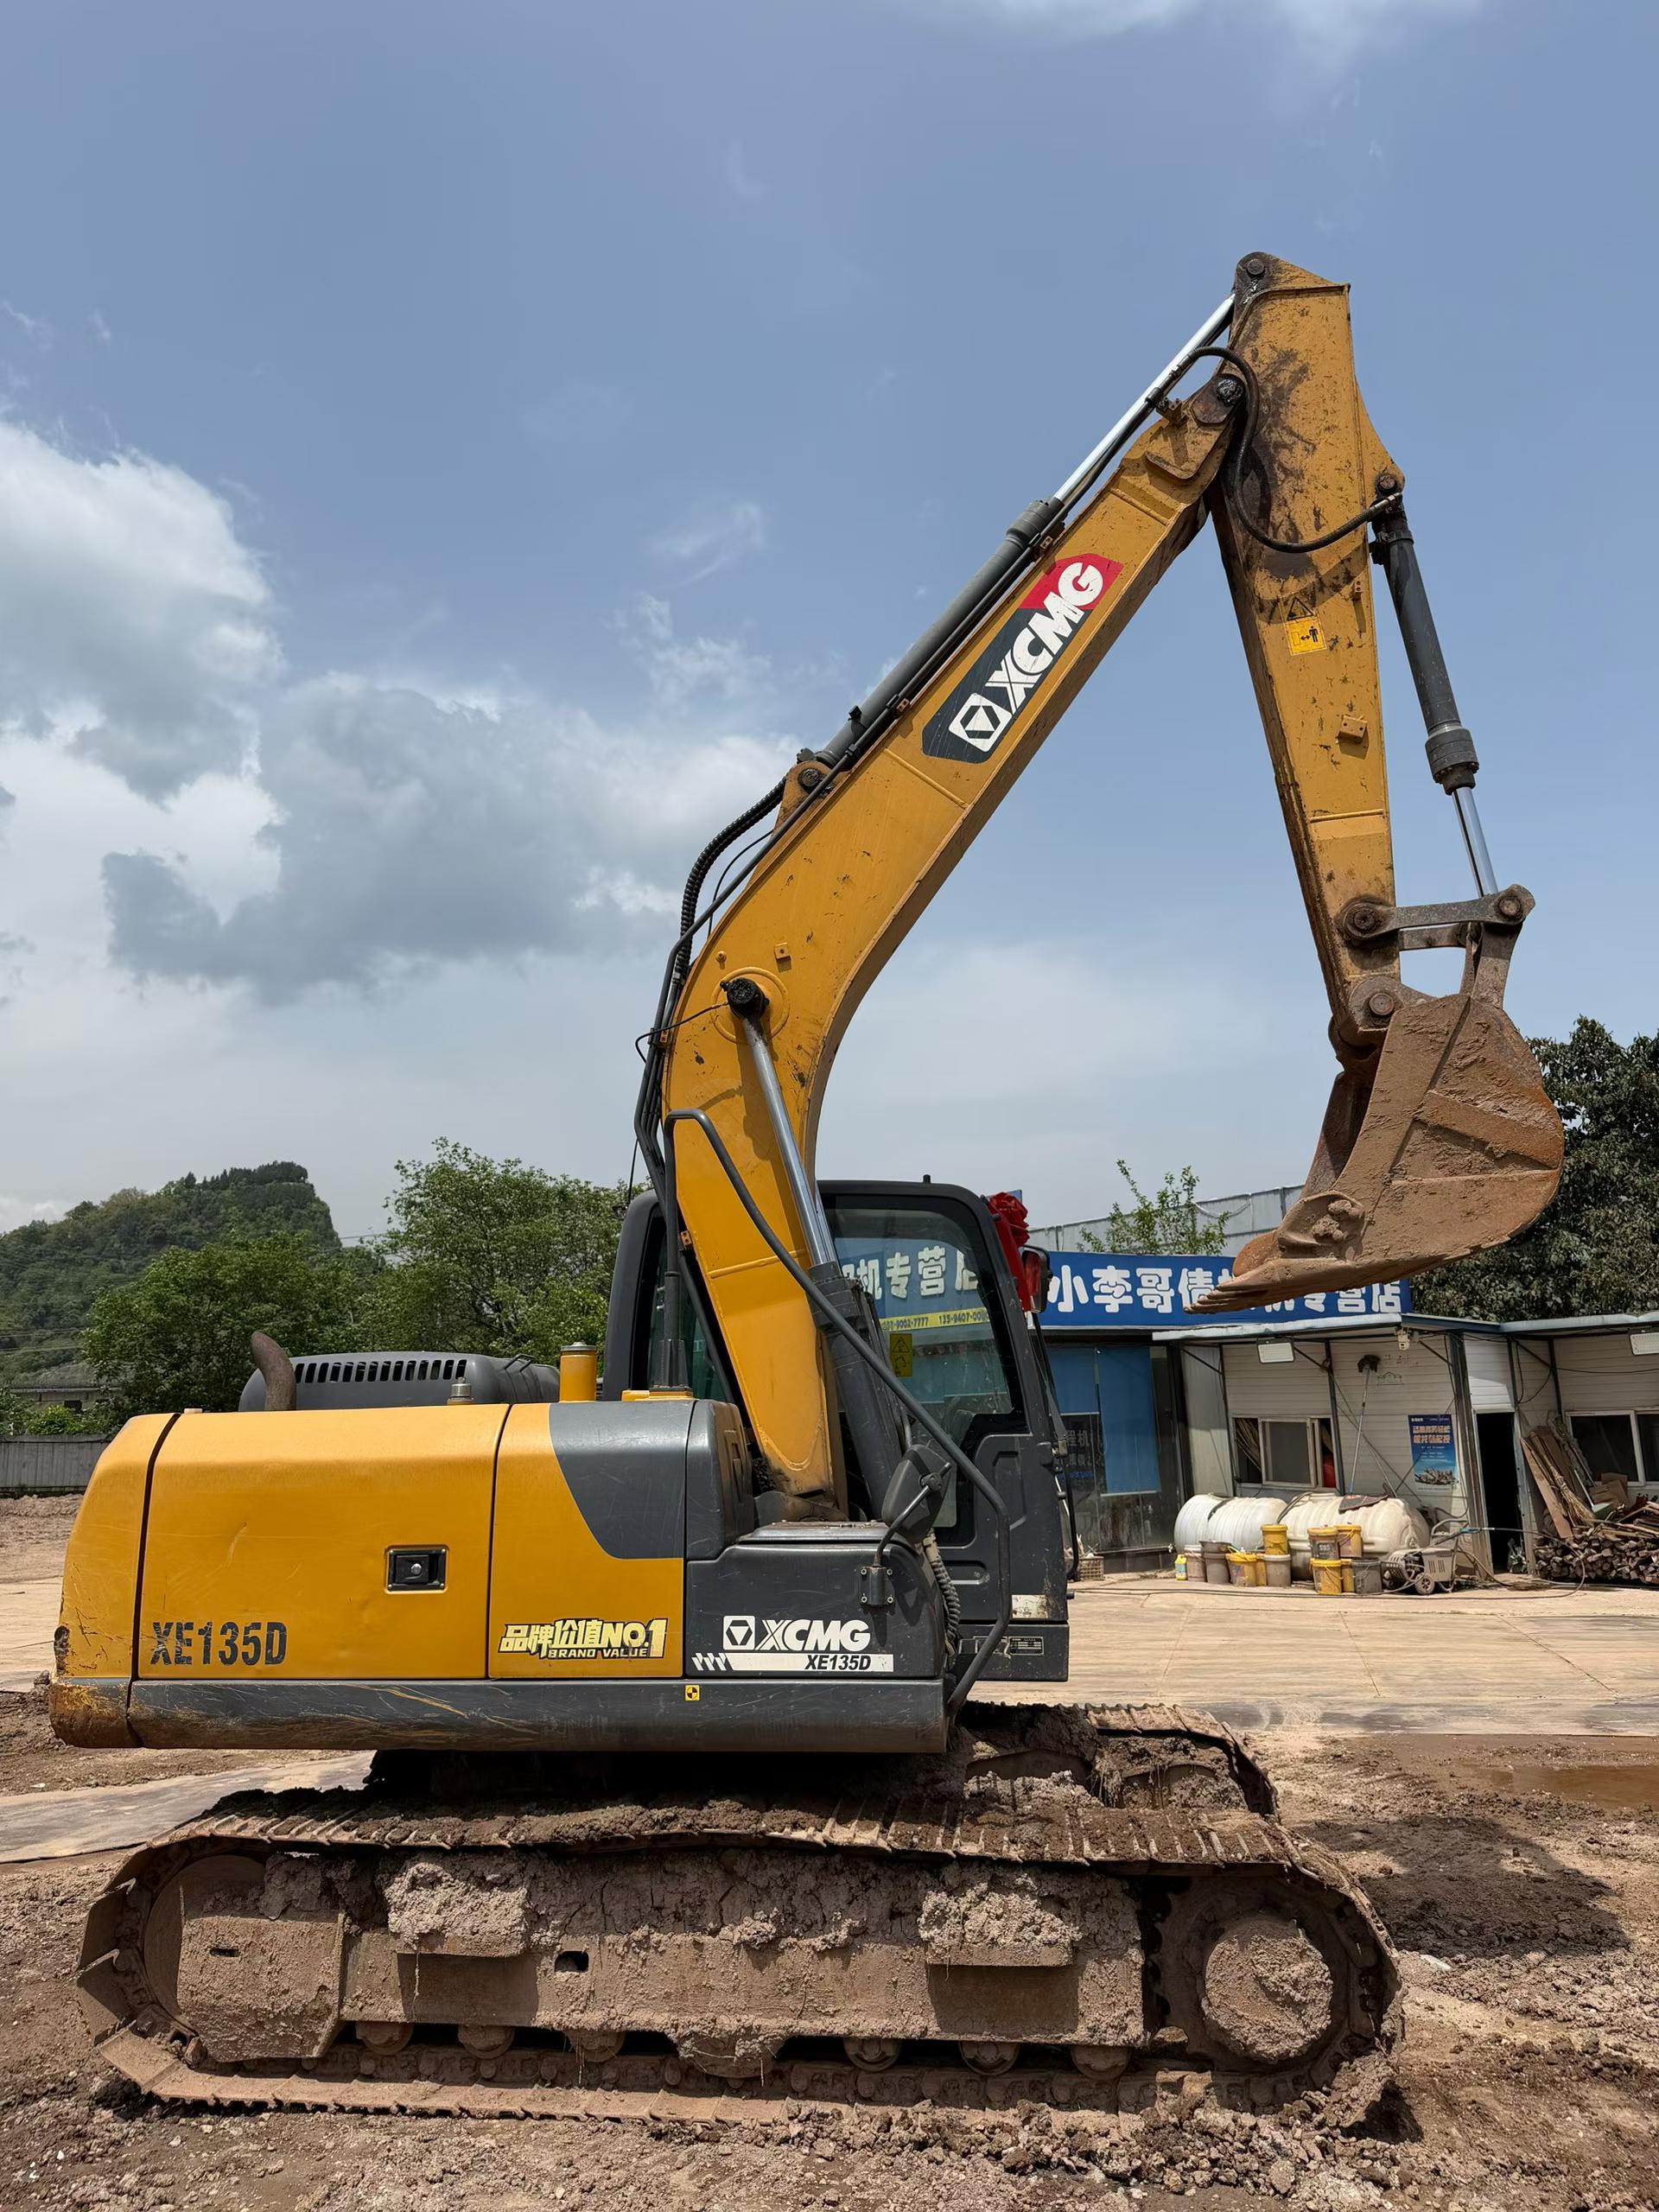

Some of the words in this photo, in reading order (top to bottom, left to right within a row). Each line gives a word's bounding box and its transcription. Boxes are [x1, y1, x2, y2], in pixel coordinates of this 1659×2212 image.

[984, 562, 1104, 715] XCMG
[149, 1621, 288, 1666] XE135D
[754, 1618, 871, 1652] XCMG
[548, 1649, 596, 1658] BRAND
[602, 1648, 648, 1658] VALUE
[804, 1654, 872, 1670] XE135D
